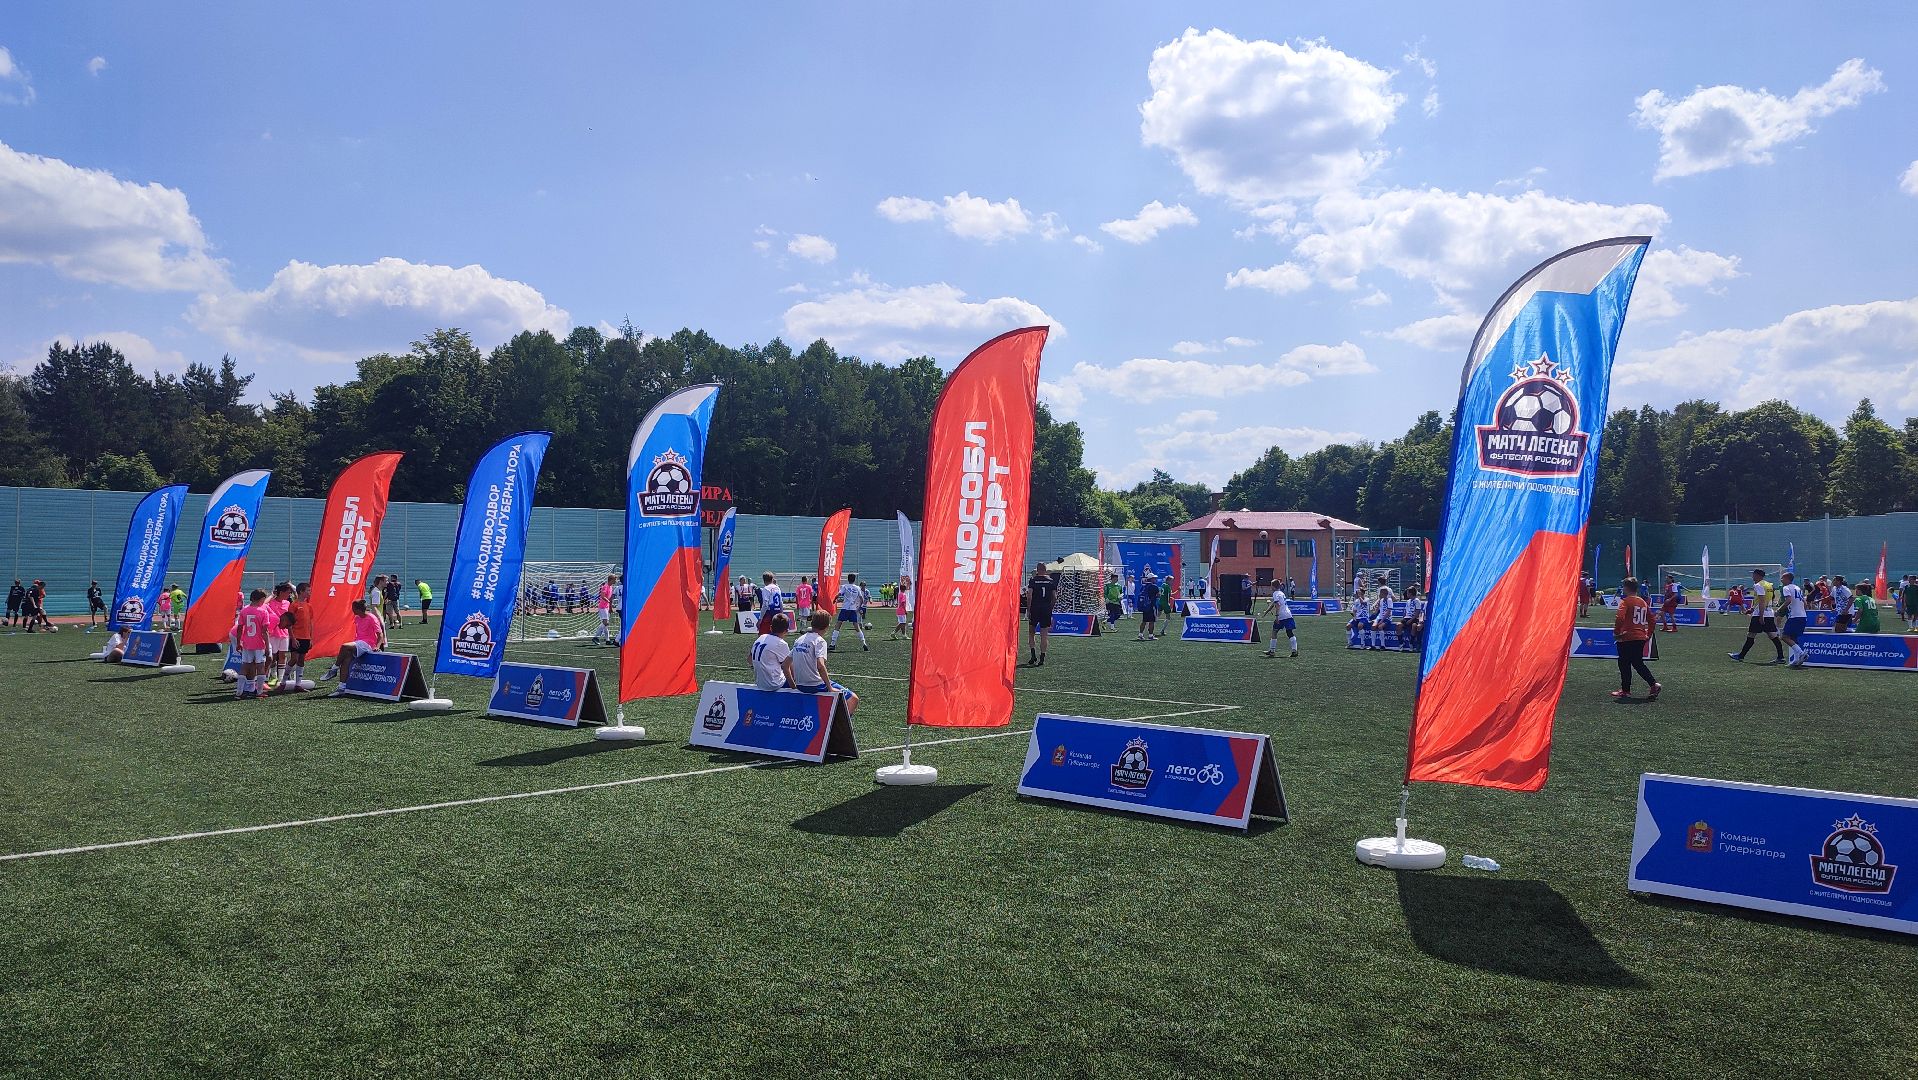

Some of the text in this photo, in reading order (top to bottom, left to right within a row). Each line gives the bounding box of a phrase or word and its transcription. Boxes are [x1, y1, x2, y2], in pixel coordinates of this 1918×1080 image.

[1487, 434, 1579, 458] МАТЧ ЛЕГЕНД
[1489, 453, 1573, 466] ФУТБОЛА РОССИИ
[644, 493, 694, 506] МАТЧ ЛЕГЕНД
[701, 485, 732, 501] ИРА
[953, 421, 987, 583] МОСОБЛ
[483, 443, 523, 602] #КОМАНДАГУБЕРНАТОРА
[980, 456, 1010, 583] СПОРТ
[330, 496, 360, 584] МОСОБЛ
[346, 515, 372, 585] СПОРТ
[471, 484, 500, 600] #ВЫХОДИВОДВОР
[774, 595, 780, 607] 3
[1865, 599, 1877, 610] 10
[1632, 605, 1648, 625] 50
[246, 614, 257, 637] 5
[752, 641, 768, 662] 11
[1802, 641, 1876, 650] #ВЫХОДИВОДВОР
[1802, 648, 1905, 659] #КОМАНДАГУБЕРНАТОРА
[1166, 764, 1197, 776] лето
[1720, 831, 1766, 845] Команда
[1719, 842, 1786, 859] Губернатора
[1818, 861, 1886, 881] МАТЧ ЛЕГЕНД
